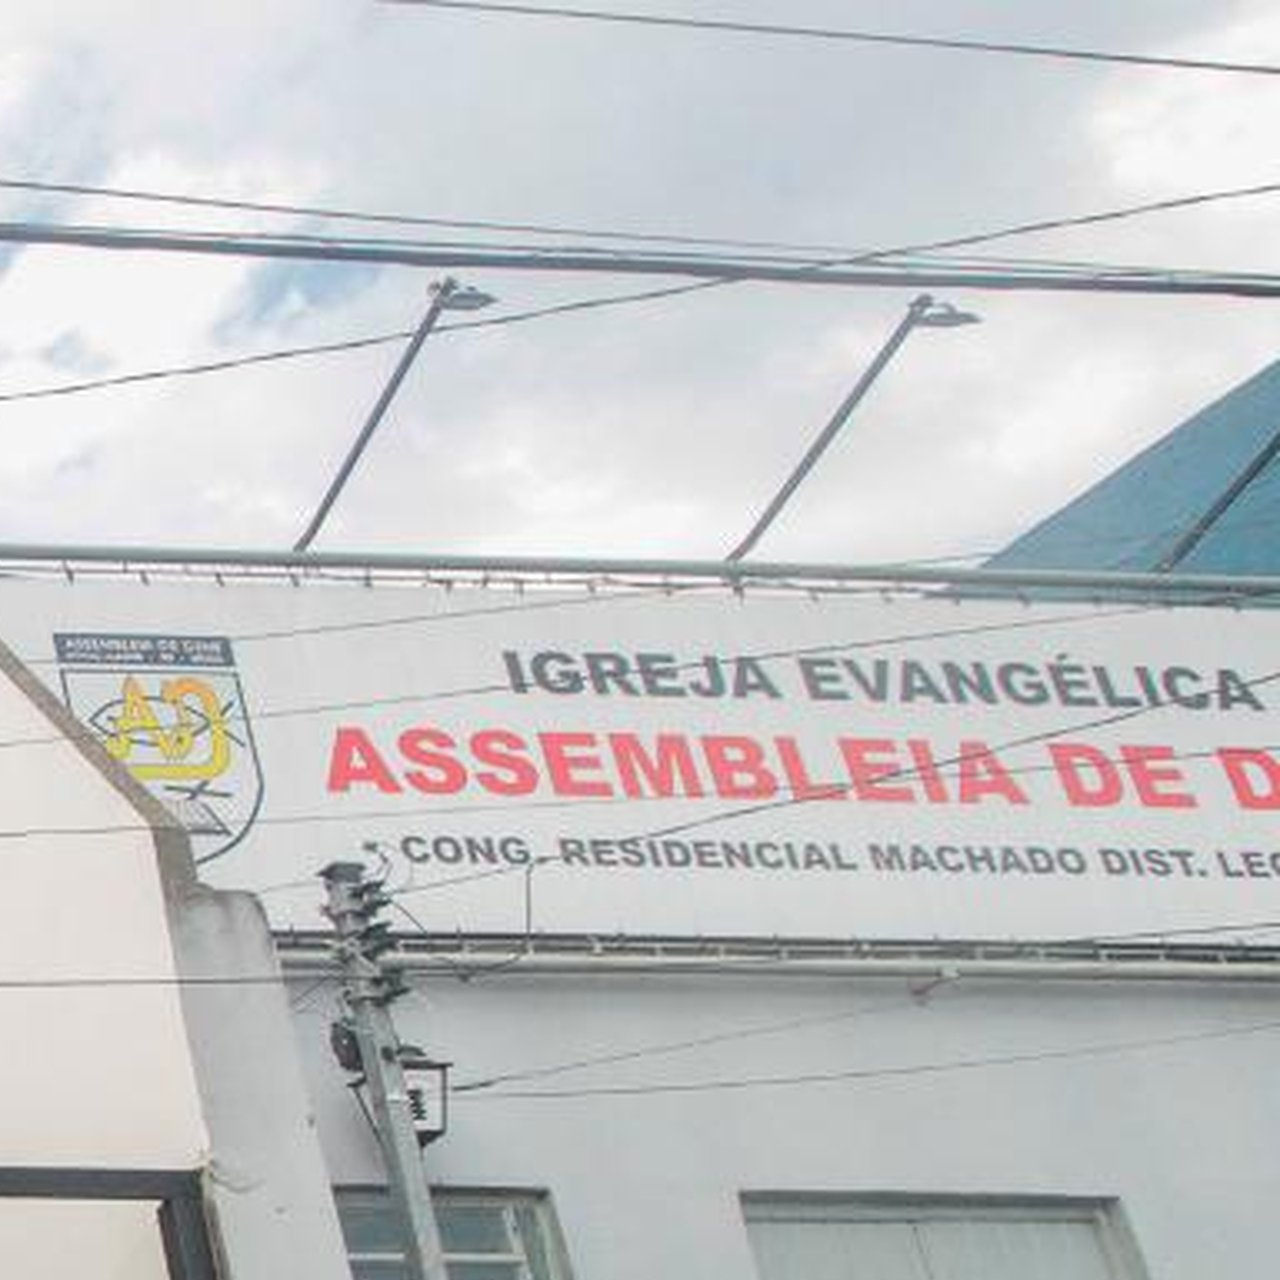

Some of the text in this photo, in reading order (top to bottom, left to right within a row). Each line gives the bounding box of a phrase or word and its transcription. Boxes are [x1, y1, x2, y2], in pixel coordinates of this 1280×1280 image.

[502, 650, 1268, 711] IGREJA EVANGÉLICA
[326, 725, 1030, 804] ASSEMBLEIA
[1047, 742, 1199, 809] DE
[557, 838, 857, 871] RESIDENCIAL
[868, 843, 1088, 874] MACHADO
[1098, 848, 1208, 878] DIST.
